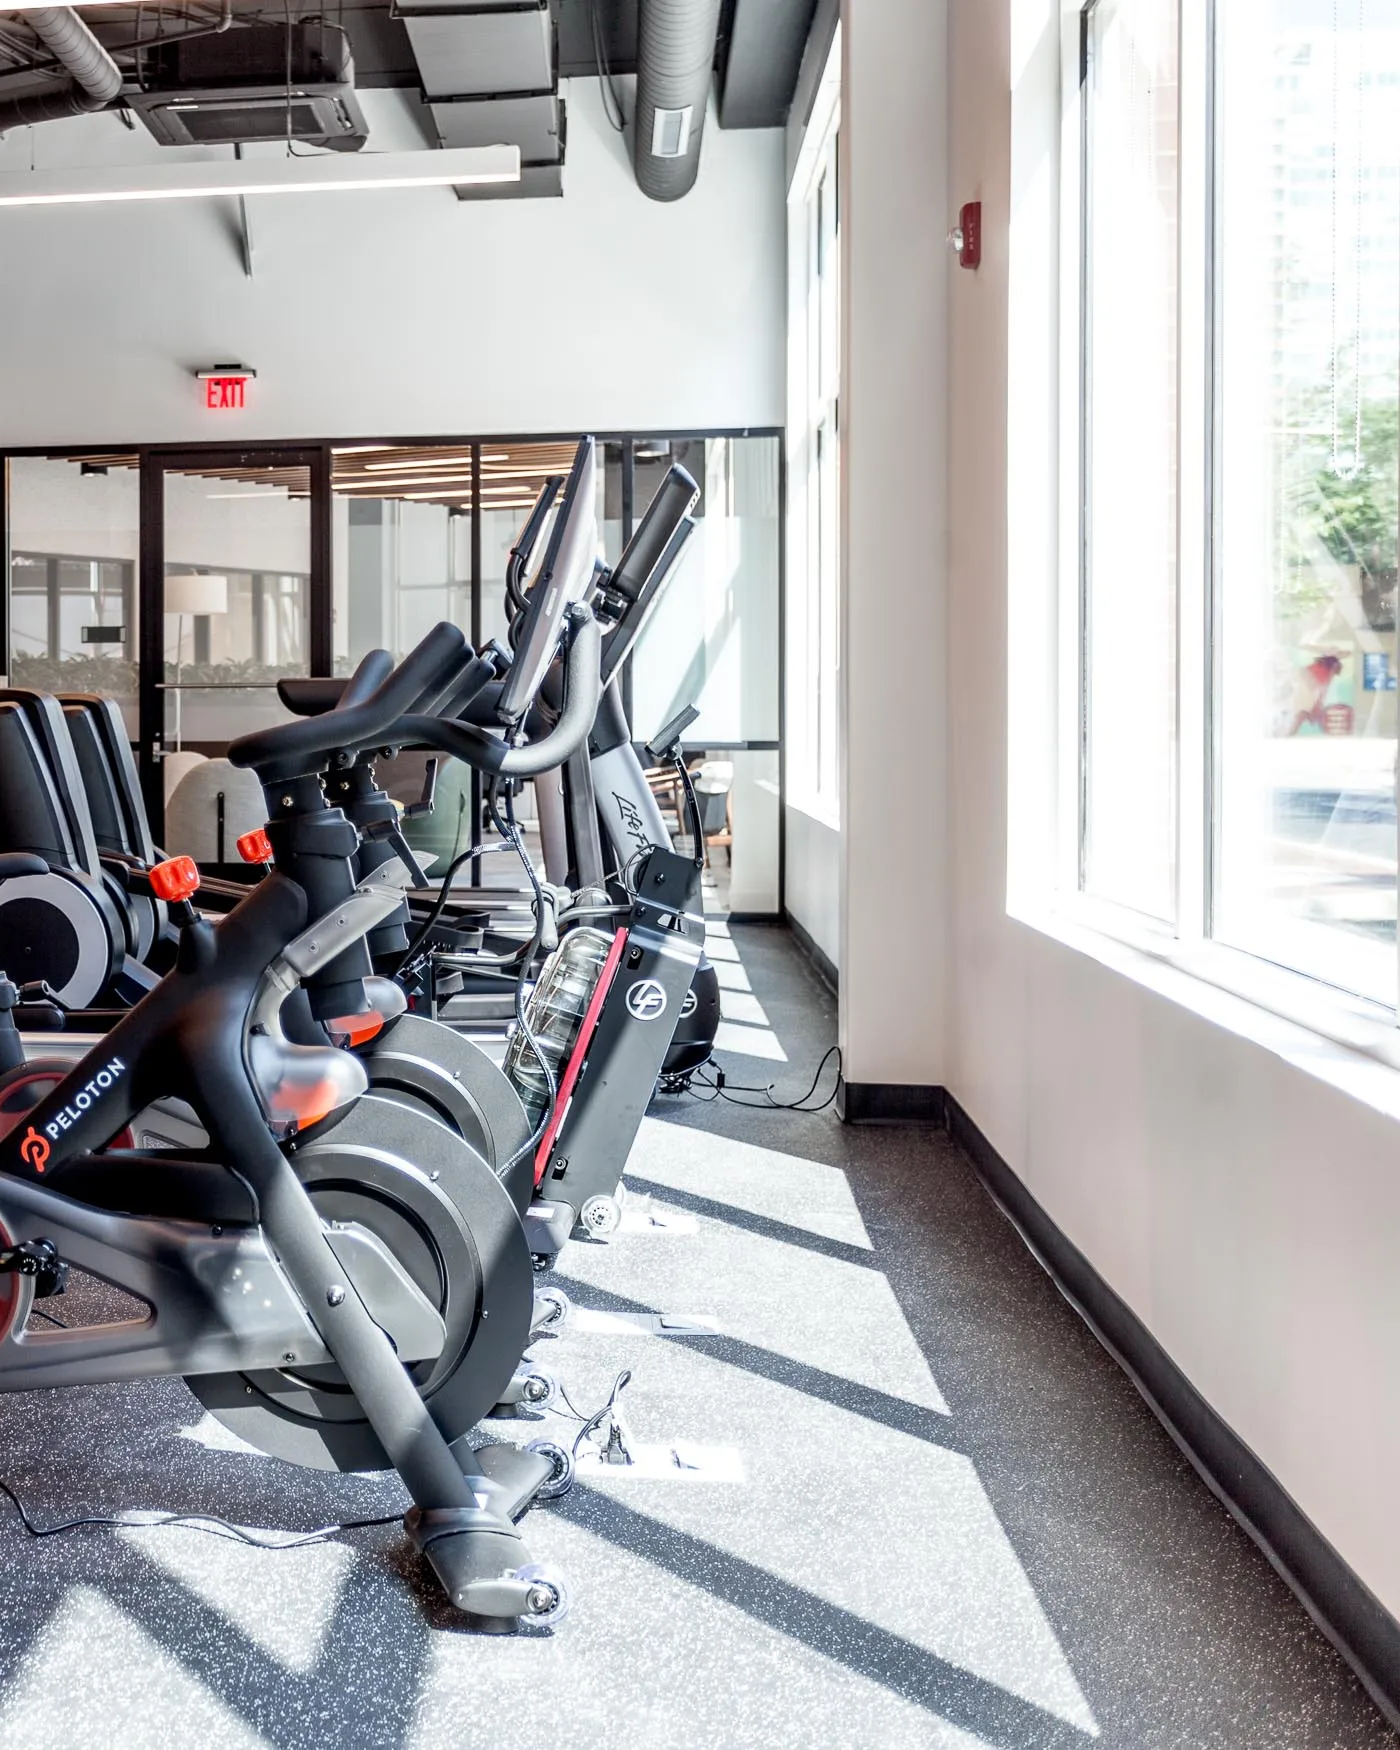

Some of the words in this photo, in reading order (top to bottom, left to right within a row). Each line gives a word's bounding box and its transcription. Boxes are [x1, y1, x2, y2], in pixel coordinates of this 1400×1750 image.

[207, 378, 247, 408] EXIT
[611, 791, 643, 831] Life
[45, 1056, 126, 1140] PELOTON
